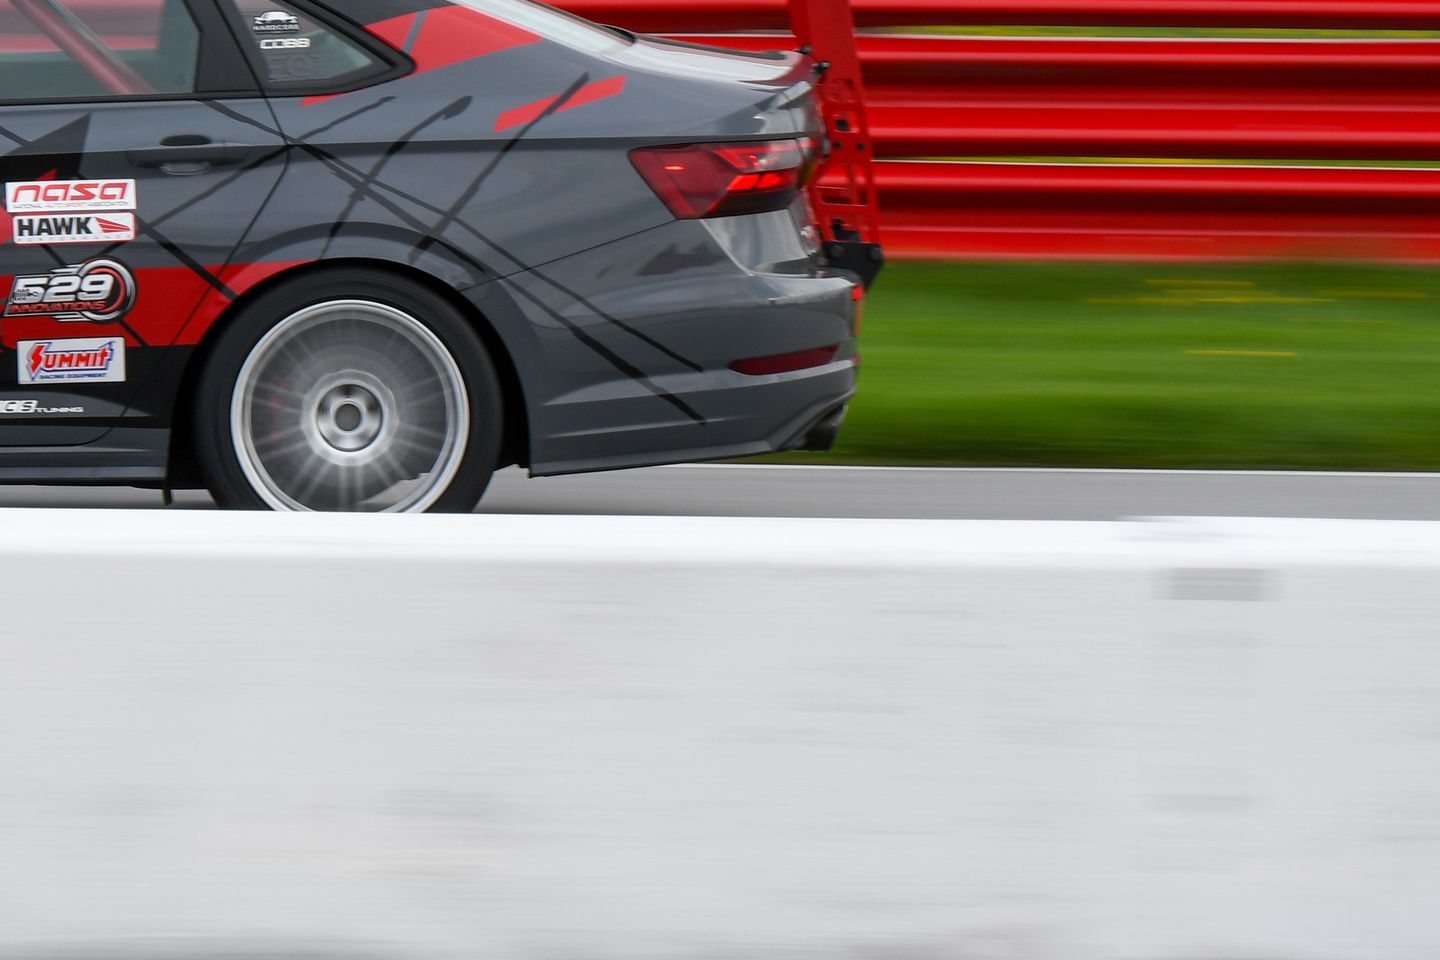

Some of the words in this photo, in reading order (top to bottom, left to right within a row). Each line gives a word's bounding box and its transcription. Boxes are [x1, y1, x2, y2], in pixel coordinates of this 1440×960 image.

[17, 216, 93, 236] HAWK
[10, 273, 115, 304] 529
[9, 300, 107, 314] INNOVATIONS
